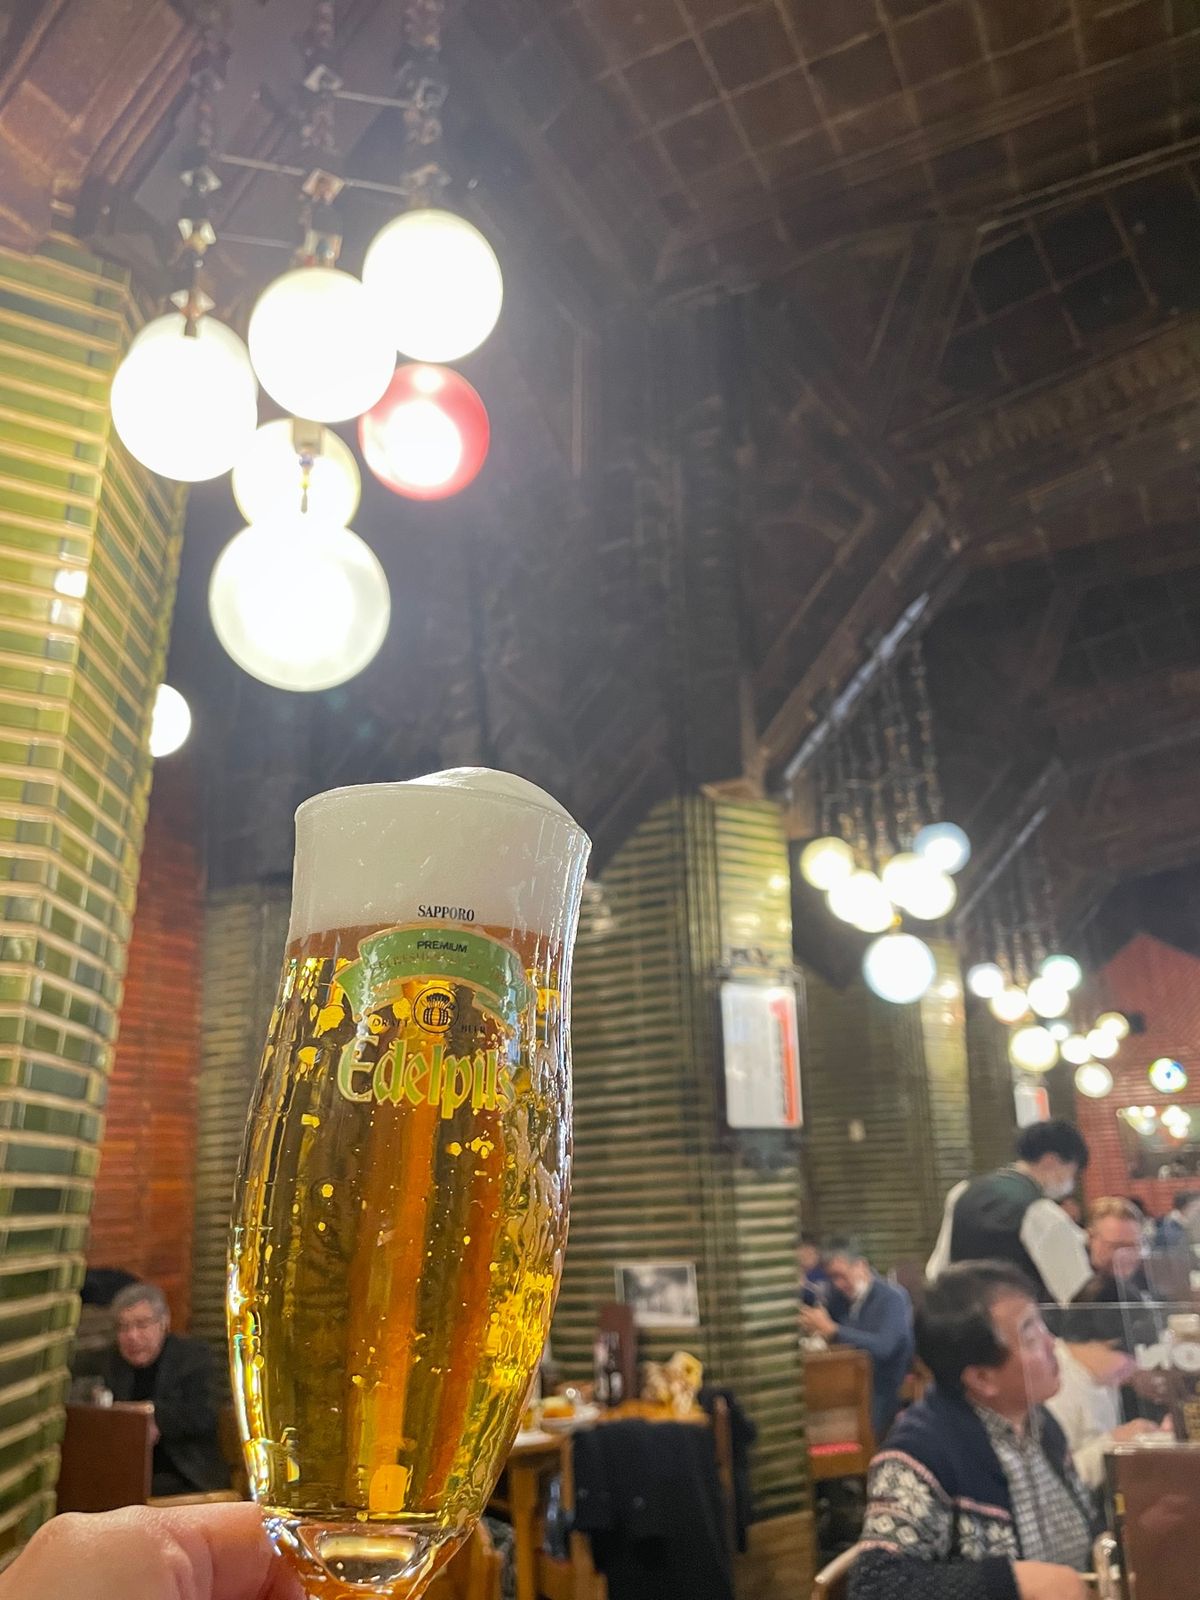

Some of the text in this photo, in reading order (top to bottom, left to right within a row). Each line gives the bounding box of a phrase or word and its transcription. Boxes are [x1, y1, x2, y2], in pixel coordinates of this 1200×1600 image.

[417, 904, 475, 922] SAPPORO
[416, 940, 468, 953] PREMIUM
[337, 1035, 516, 1120] Edelpils
